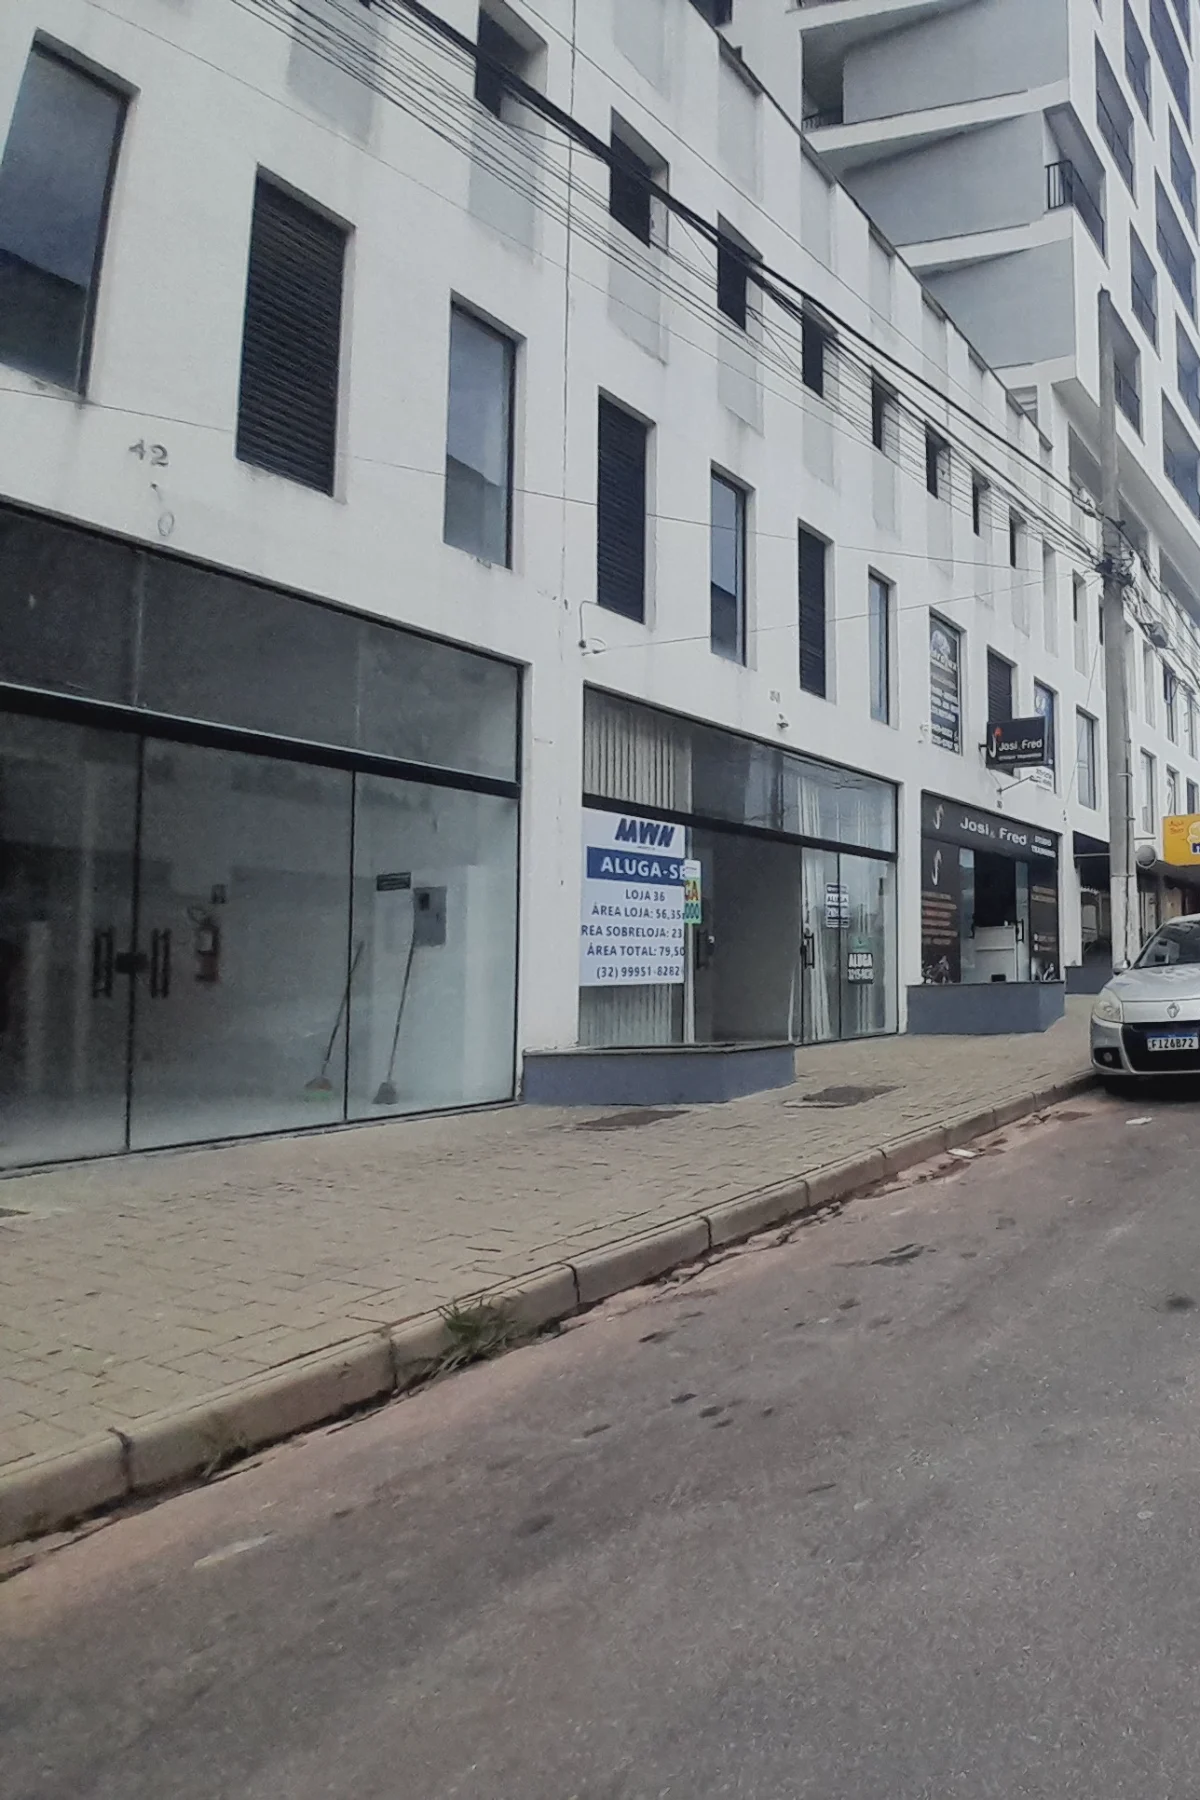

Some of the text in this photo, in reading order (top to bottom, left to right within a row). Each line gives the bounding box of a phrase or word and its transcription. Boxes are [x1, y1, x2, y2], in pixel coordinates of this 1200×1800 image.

[1021, 739, 1043, 749] Fred
[960, 817, 989, 835] Josi
[999, 827, 1027, 846] Fred
[625, 889, 666, 902] LOJA 36
[591, 901, 621, 917] ÁREA
[624, 907, 654, 918] LOJA:
[580, 924, 684, 939] REA SOBRELOJA: 23
[586, 942, 617, 956] ÁREA
[620, 945, 657, 956] TOTAL:
[596, 966, 619, 980] (32)
